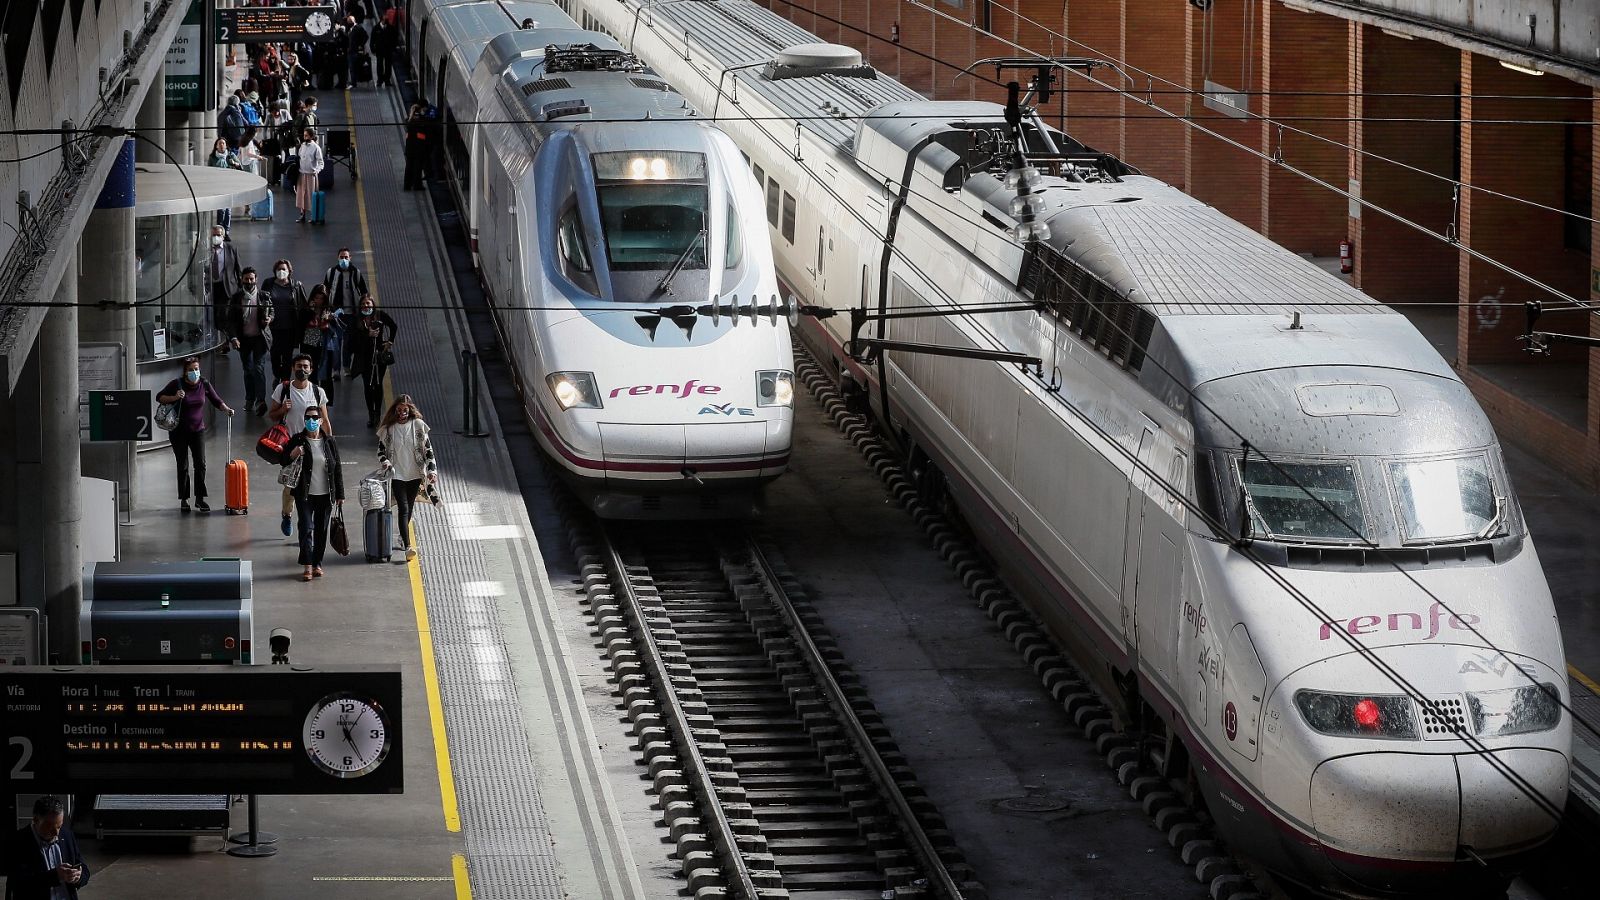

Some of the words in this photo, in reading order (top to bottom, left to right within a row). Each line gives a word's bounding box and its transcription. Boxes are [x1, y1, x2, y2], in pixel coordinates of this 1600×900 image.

[220, 26, 229, 40] 2
[166, 46, 186, 54] aria
[608, 379, 722, 399] renfe
[698, 402, 756, 417] AVE
[136, 415, 149, 438] 2
[1182, 601, 1207, 639] renfe
[1319, 601, 1482, 641] renfe
[1457, 652, 1539, 679] AVE
[7, 684, 26, 697] Vía
[61, 685, 90, 697] Hora
[103, 689, 121, 697] TIME
[133, 686, 160, 697] Tren
[175, 689, 195, 697] TRAIN
[7, 704, 41, 712] PLATFORM
[339, 703, 355, 713] 12
[1226, 708, 1237, 734] 13
[63, 723, 107, 735] Destino
[121, 727, 165, 735] DESTINATION
[315, 729, 325, 740] 9
[369, 729, 379, 739] 3
[8, 735, 35, 780] 2
[343, 756, 353, 766] 6
